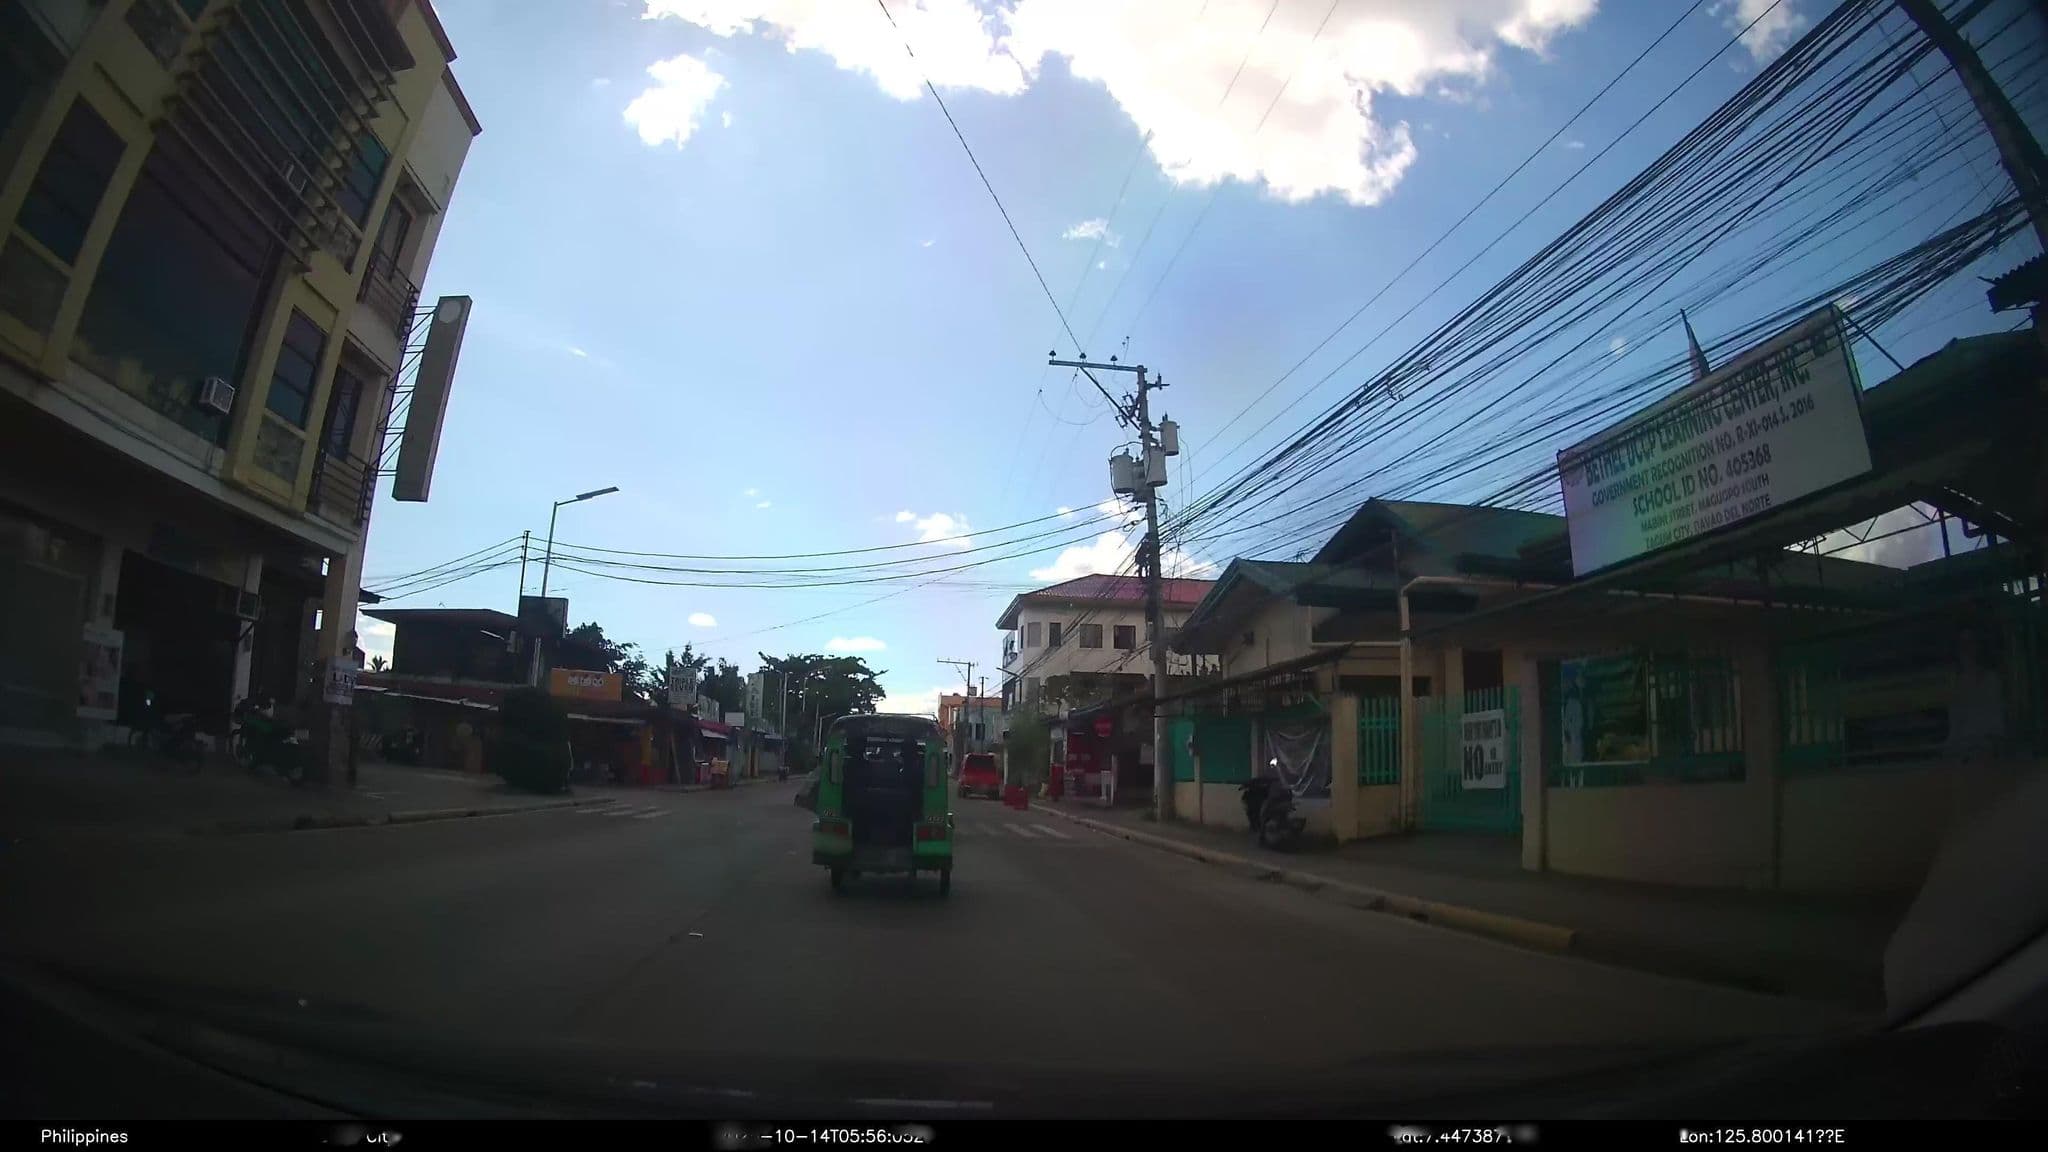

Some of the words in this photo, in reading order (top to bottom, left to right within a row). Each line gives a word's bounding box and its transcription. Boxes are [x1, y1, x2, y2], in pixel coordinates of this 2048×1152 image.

[1592, 469, 1649, 506] GOVERNMENT
[1651, 443, 1715, 482] RECOGNITION
[1715, 431, 1736, 453] NO.
[1736, 411, 1779, 442] R-XI-014
[1790, 391, 1815, 420] 2016
[1632, 480, 1681, 517] SCHOOL
[1681, 474, 1697, 498] ID
[1697, 463, 1723, 491] NO.
[1726, 443, 1772, 478] 405368
[1693, 511, 1721, 533] DAVAO
[1463, 744, 1484, 781] NO
